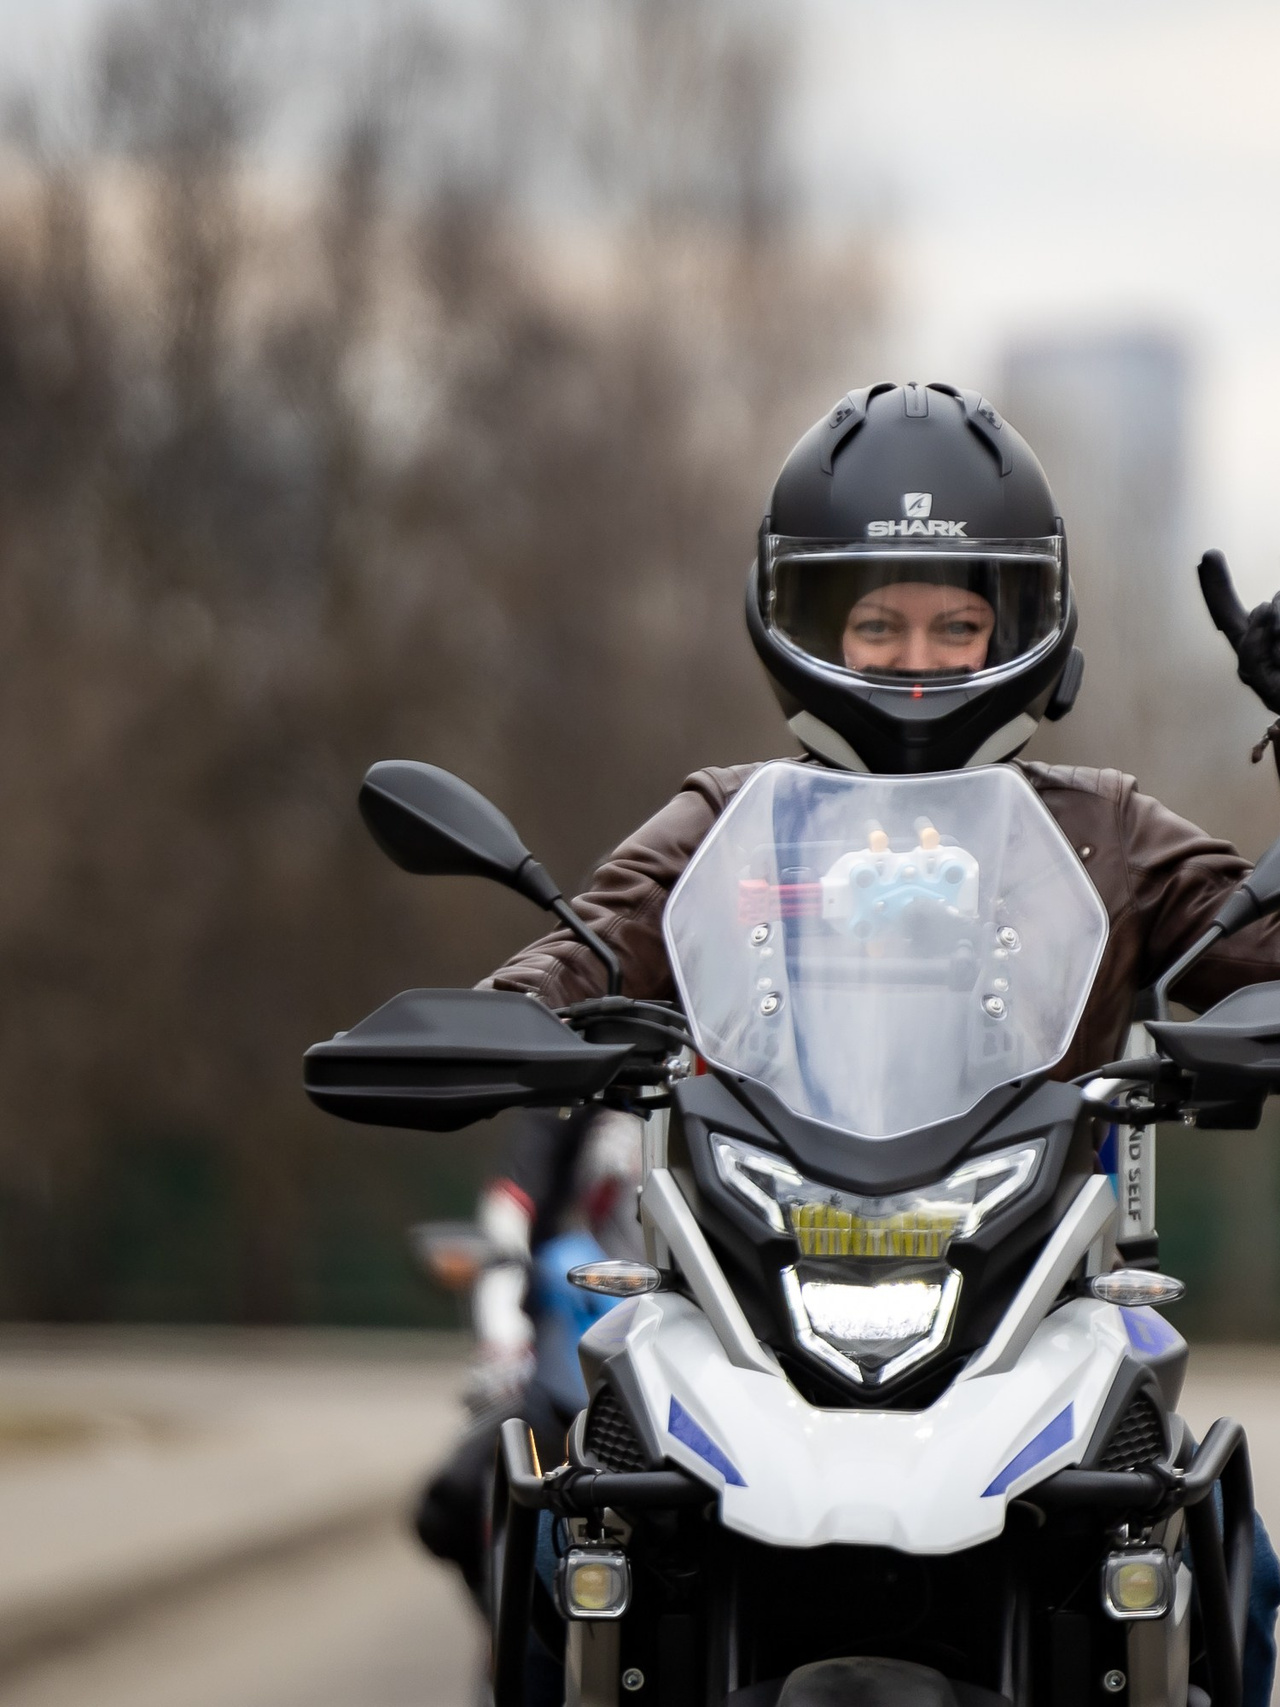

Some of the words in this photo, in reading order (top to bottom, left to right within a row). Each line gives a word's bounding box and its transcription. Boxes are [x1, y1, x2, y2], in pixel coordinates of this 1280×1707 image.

[868, 520, 968, 537] SHARK
[1128, 1124, 1142, 1161] ND
[1127, 1168, 1142, 1221] SELF
